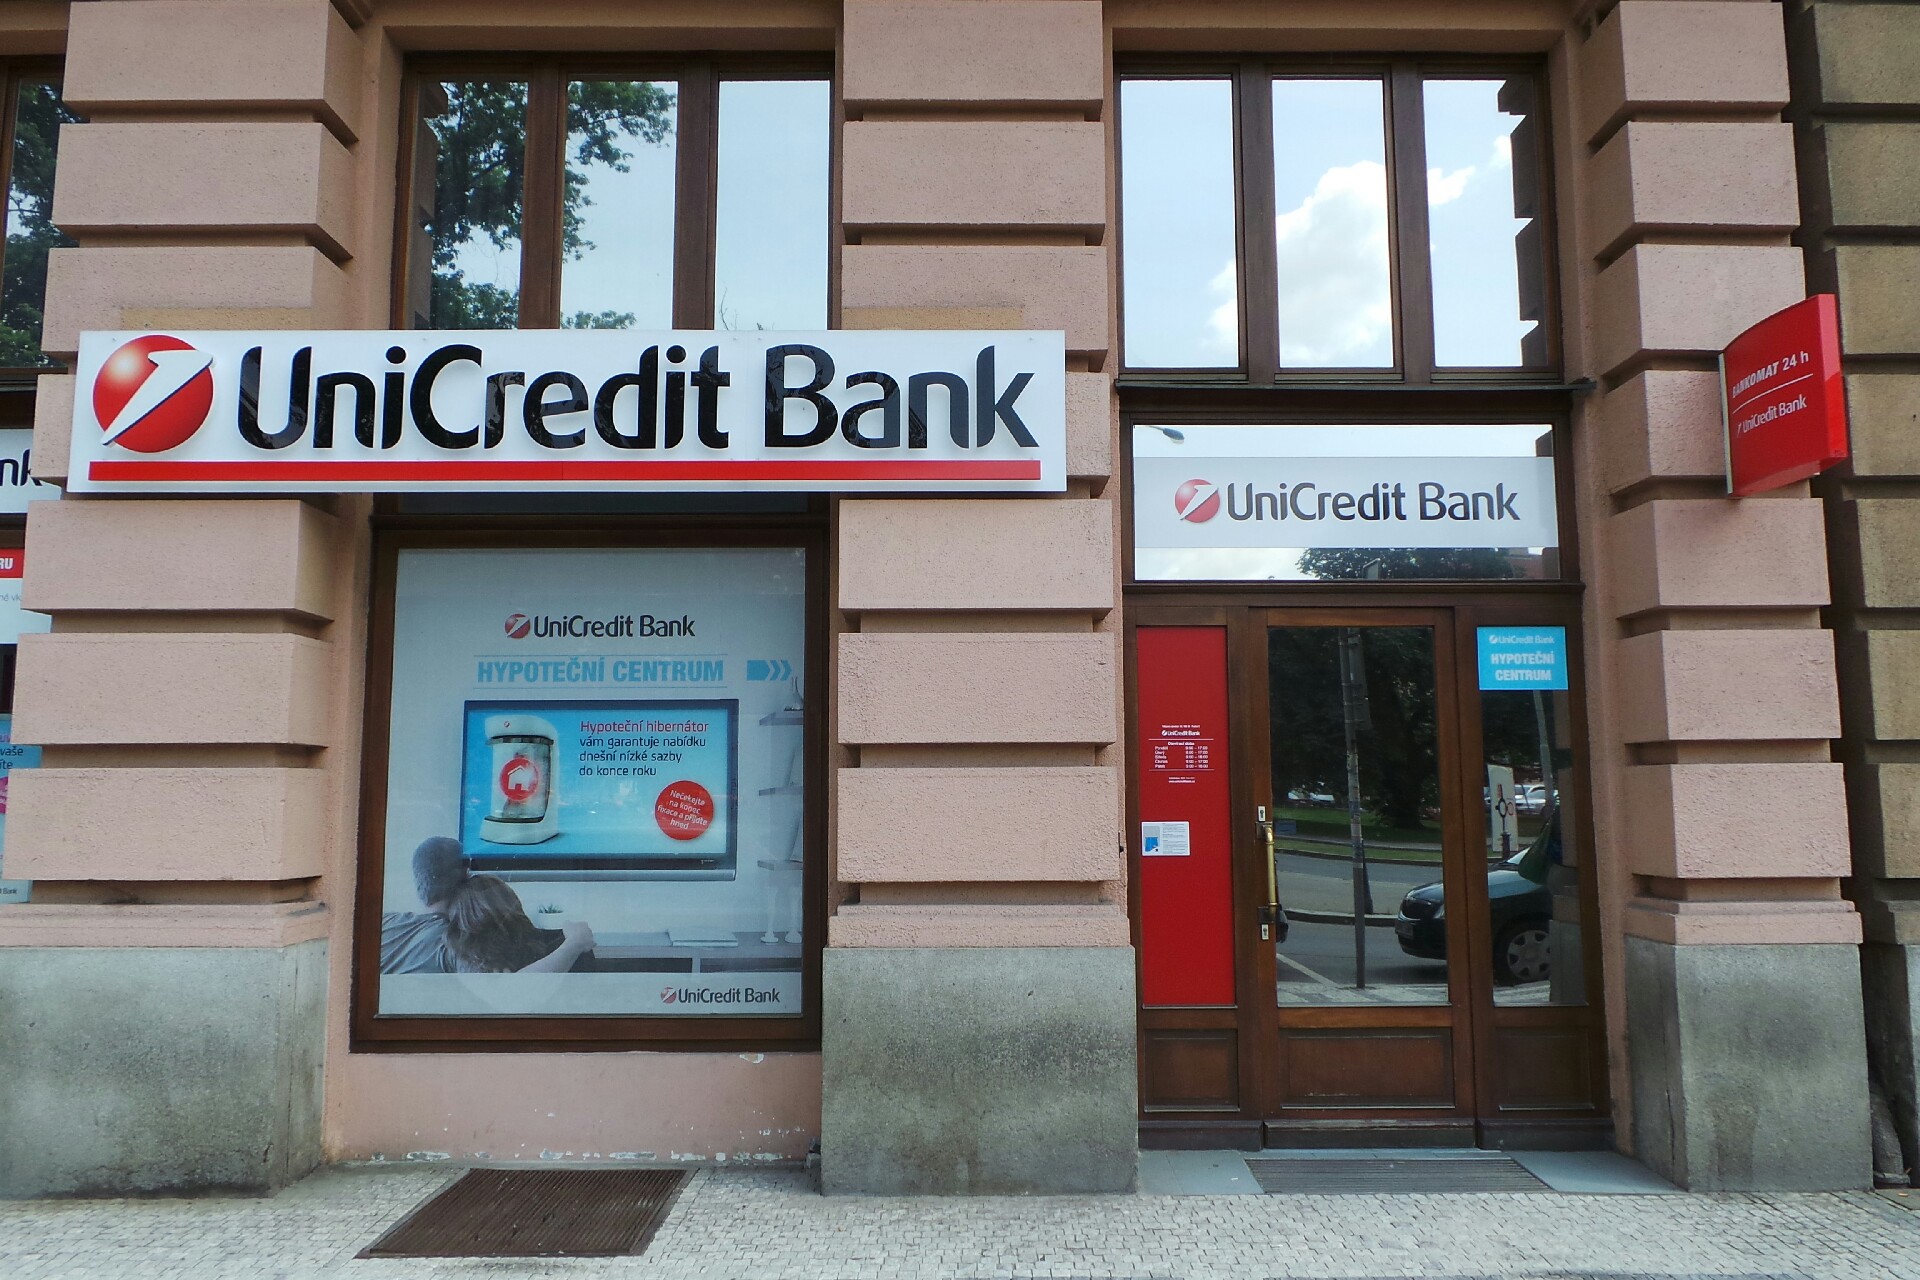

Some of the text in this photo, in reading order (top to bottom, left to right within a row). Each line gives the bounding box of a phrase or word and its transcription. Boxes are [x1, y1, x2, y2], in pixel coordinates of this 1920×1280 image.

[1733, 350, 1809, 398] BANKOMAT 24 h
[237, 342, 1041, 450] UniCredit Bank
[1742, 394, 1807, 433] UniCredit Bank
[1227, 481, 1521, 521] UniCredit Bank
[533, 614, 696, 639] UniCredit Bank
[1499, 635, 1555, 644] UniCredit Bank
[1491, 651, 1555, 665] HYPOTEČNÍ
[477, 656, 725, 683] HYPOTEČNÍ CENTRUM
[1495, 670, 1552, 681] CENTRUM
[580, 720, 709, 735] Hypoteční hibernátor
[580, 736, 706, 749] vám garantuje nabídku
[579, 750, 682, 764] dnešní nízké sazby
[579, 765, 657, 776] do konce roku
[669, 800, 679, 808] na
[678, 987, 780, 1004] UniCredit Bank
